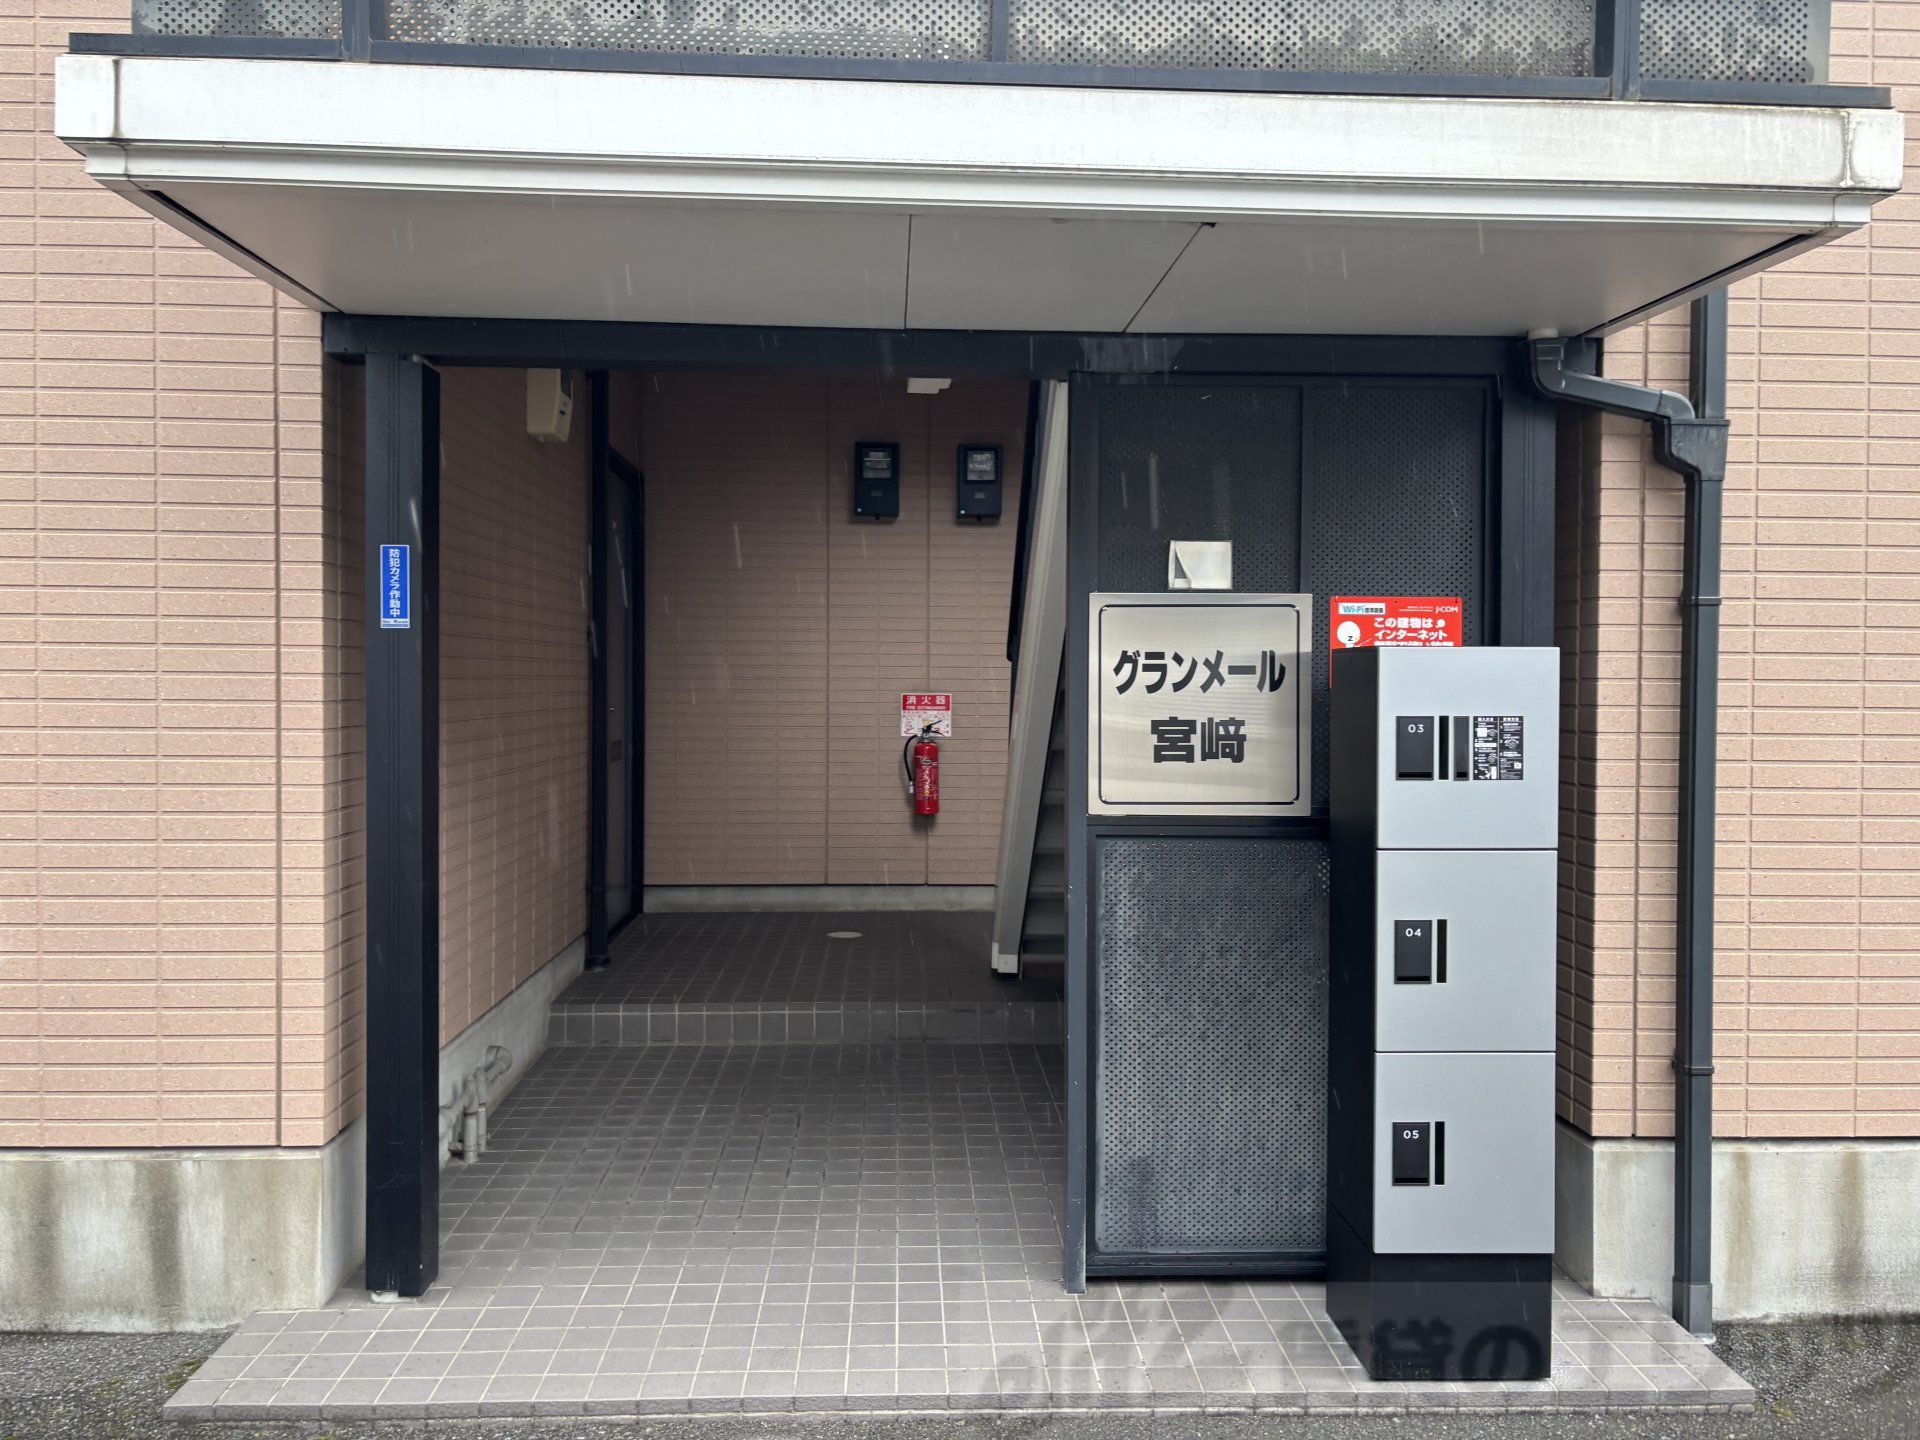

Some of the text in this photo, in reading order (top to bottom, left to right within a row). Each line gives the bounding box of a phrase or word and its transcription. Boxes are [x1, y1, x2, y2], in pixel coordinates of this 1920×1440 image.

[389, 548, 401, 618] 防犯カメラ作動中
[1374, 617, 1434, 628] この建物は
[1375, 629, 1448, 640] インターネット
[1113, 649, 1286, 696] グランメール
[906, 695, 946, 705] 消火器
[1407, 724, 1425, 733] 03
[1405, 928, 1422, 937] 04
[1403, 1130, 1419, 1139] 05
